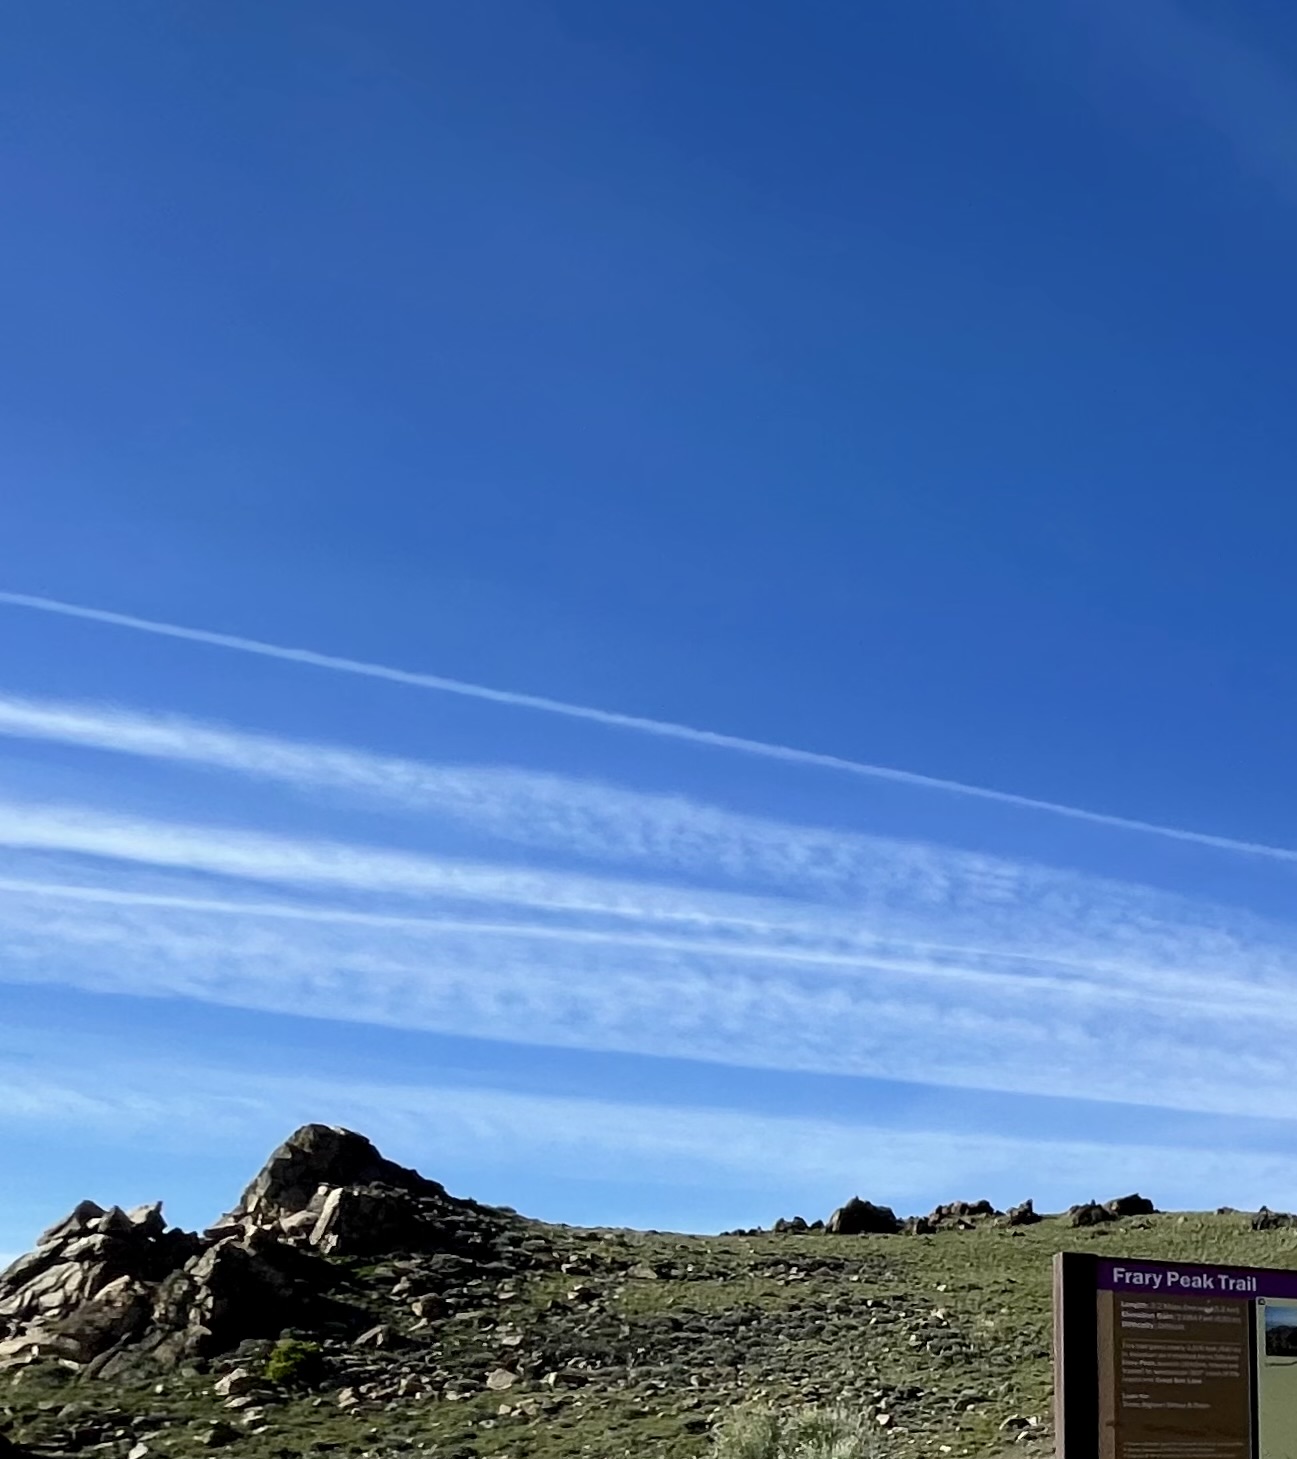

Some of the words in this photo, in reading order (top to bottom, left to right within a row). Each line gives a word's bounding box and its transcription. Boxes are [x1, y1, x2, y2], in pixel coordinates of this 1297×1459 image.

[1113, 1267, 1162, 1289] Frary
[1167, 1271, 1214, 1289] Peak
[1217, 1274, 1257, 1291] Trail
